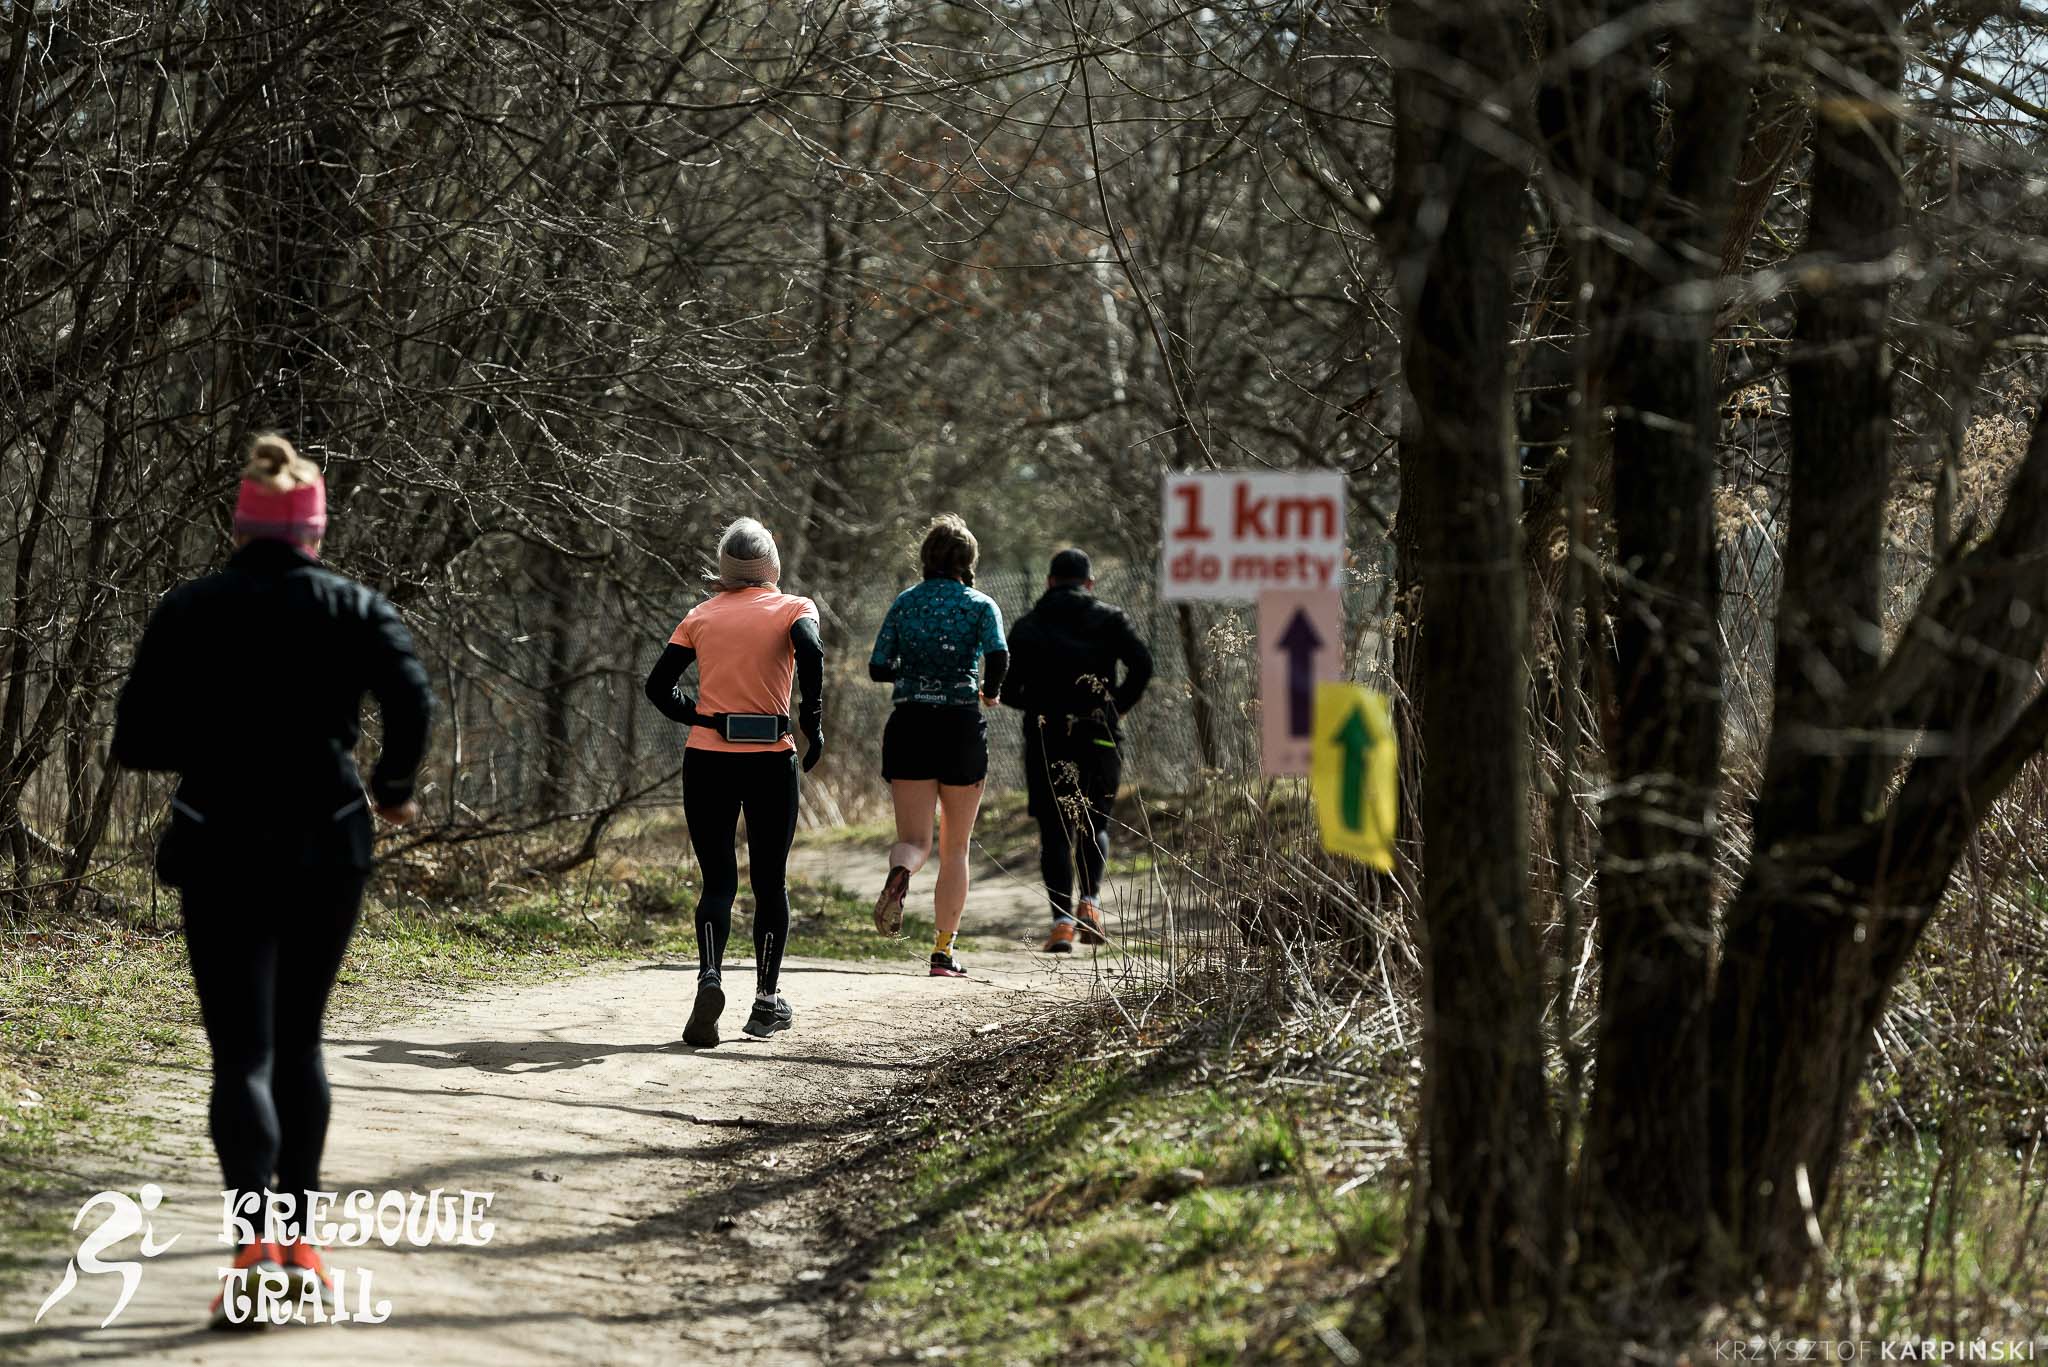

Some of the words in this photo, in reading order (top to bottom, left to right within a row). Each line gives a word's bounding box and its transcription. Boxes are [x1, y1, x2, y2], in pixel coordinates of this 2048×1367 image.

[1173, 481, 1213, 541] 1
[1233, 481, 1338, 540] km
[1171, 547, 1222, 583] do
[1230, 548, 1335, 588] mety
